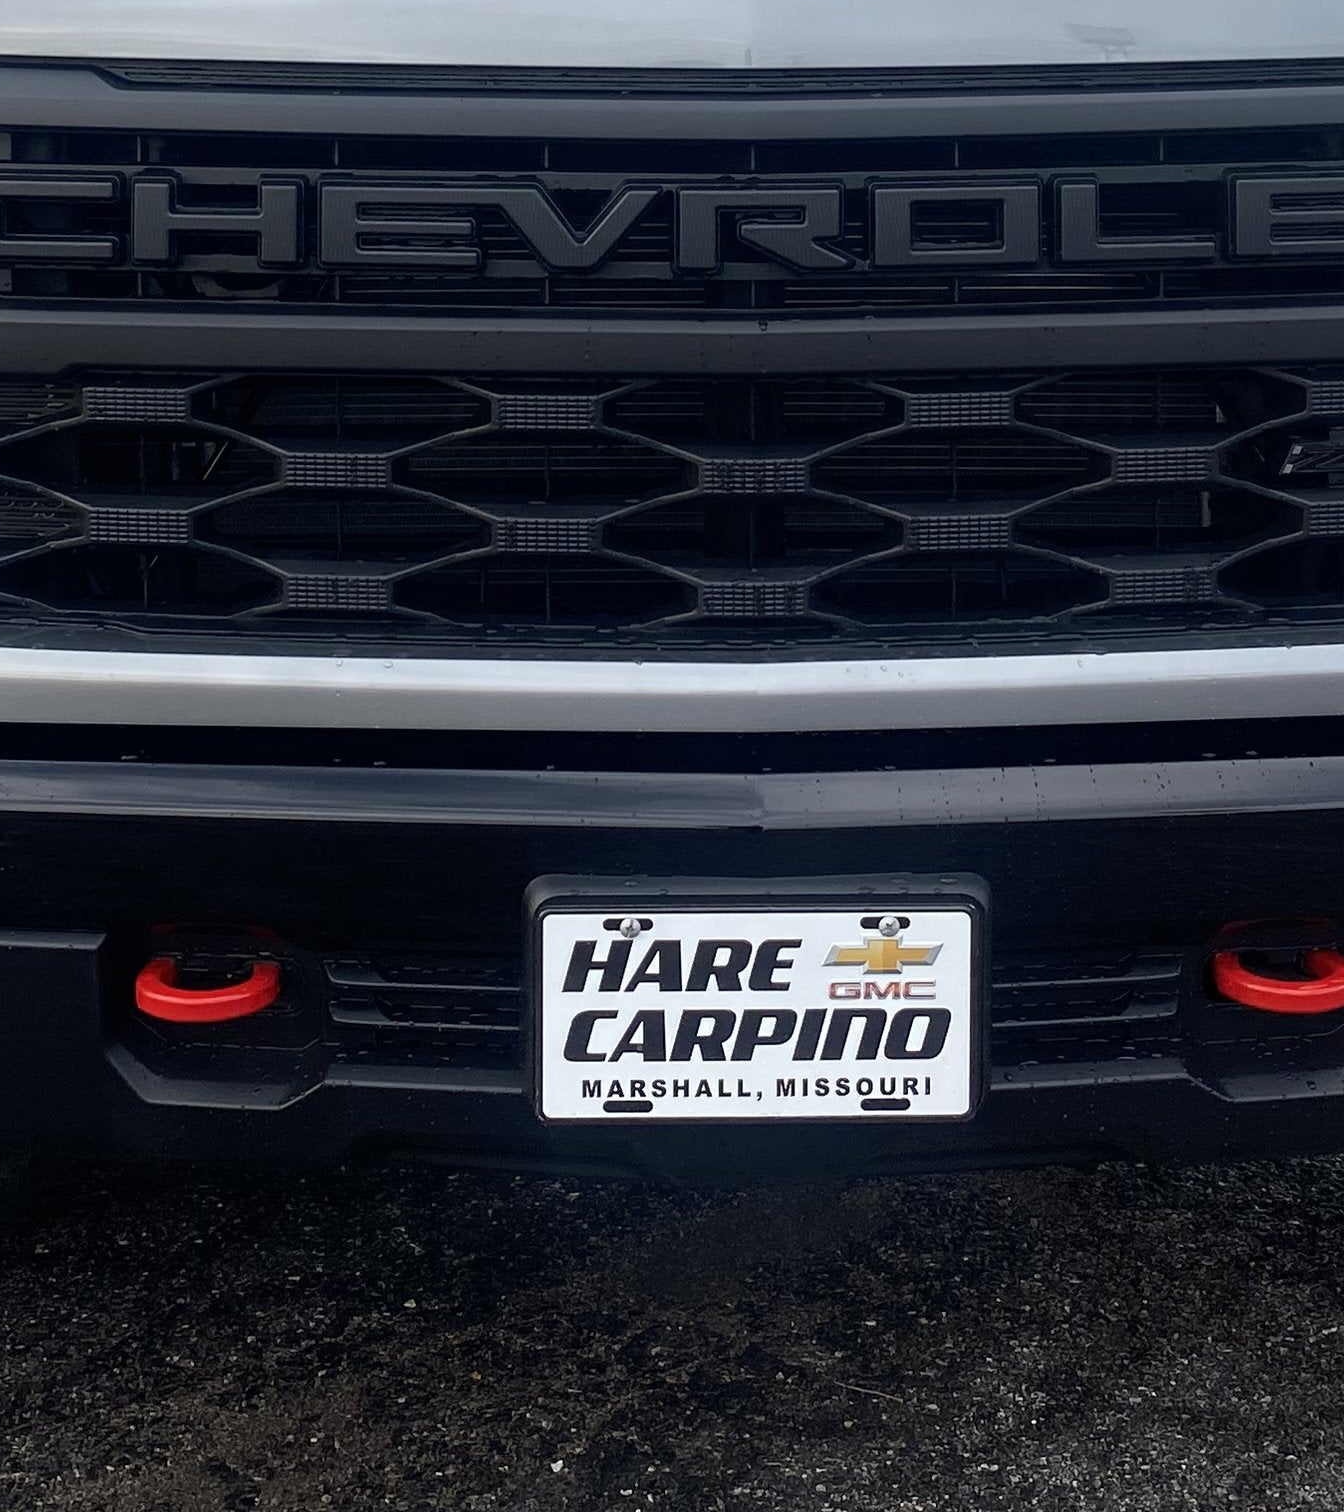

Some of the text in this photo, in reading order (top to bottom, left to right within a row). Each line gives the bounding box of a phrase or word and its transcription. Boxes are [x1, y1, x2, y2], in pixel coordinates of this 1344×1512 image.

[561, 938, 803, 993] HARE
[828, 979, 937, 1000] GMC
[562, 1007, 952, 1063] CARPINO
[581, 1076, 932, 1102] MARSHALL, MISSOURI
